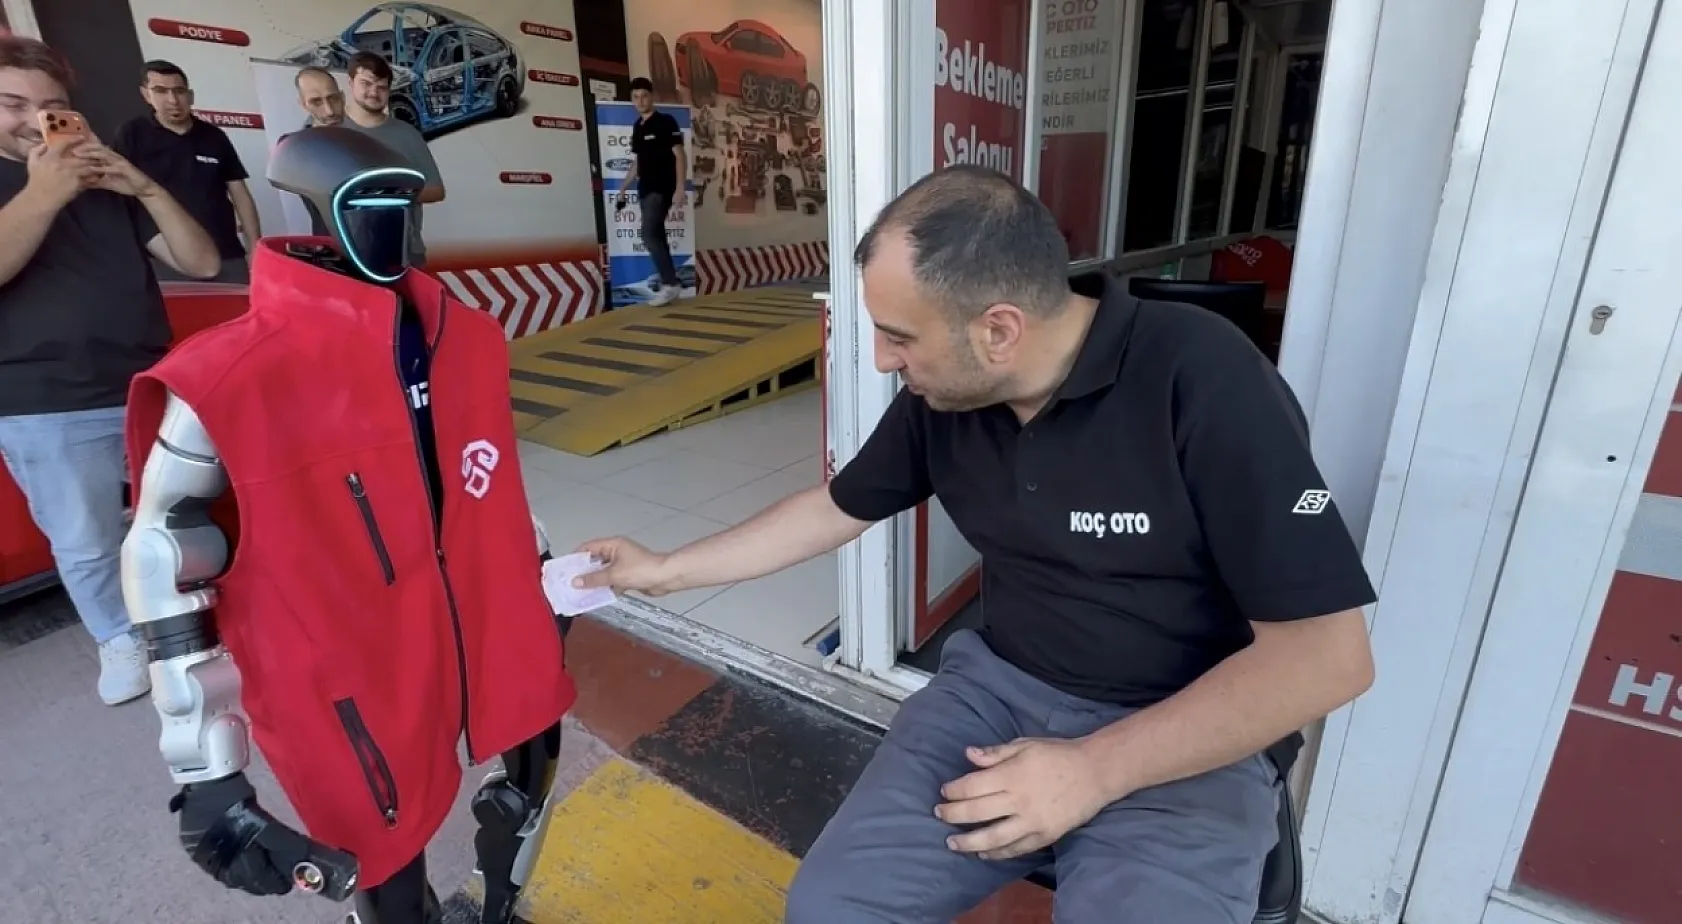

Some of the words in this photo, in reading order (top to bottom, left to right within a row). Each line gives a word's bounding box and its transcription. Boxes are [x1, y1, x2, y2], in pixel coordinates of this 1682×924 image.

[178, 25, 223, 41] PODYE
[1045, 39, 1110, 59] KLERİMİZ
[935, 27, 1024, 110] Bekleme
[1047, 66, 1096, 83] EĞERLİ
[1042, 88, 1111, 107] RİLERİMİZ
[213, 113, 254, 126] PANEL
[1043, 114, 1075, 129] NDİR
[943, 122, 1013, 177] Salonu
[614, 211, 635, 223] BYD
[616, 228, 634, 238] OTO
[1070, 511, 1105, 538] KOÇ
[1110, 512, 1150, 534] OTO
